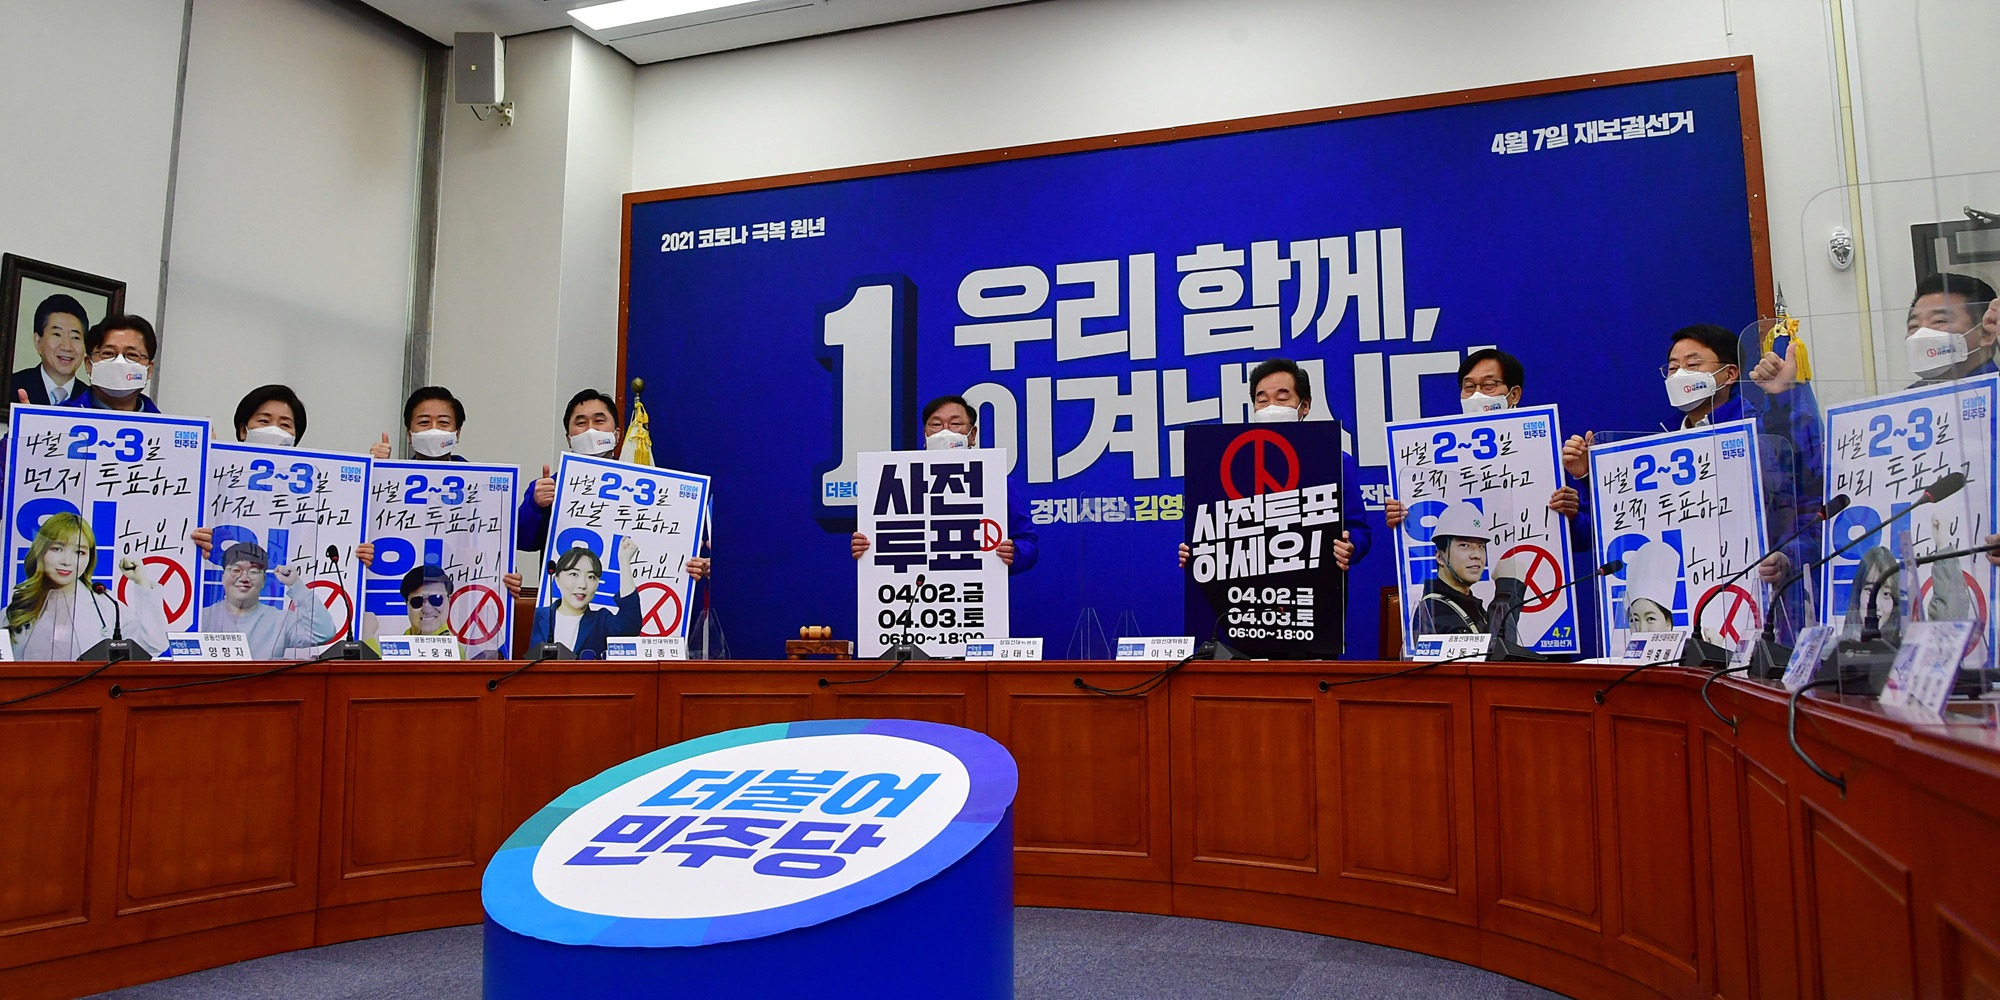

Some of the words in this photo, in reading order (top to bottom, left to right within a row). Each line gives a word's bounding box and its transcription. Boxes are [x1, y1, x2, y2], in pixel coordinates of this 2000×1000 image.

[1491, 130, 1529, 154] 4월
[1532, 124, 1569, 151] 7일
[1574, 110, 1695, 144] 재보궐선거
[661, 231, 694, 252] 2021
[698, 225, 748, 248] 코로나
[752, 221, 785, 242] 극복
[790, 217, 825, 239] 원년
[954, 252, 1156, 371] 우리
[1176, 227, 1441, 356] 함께,
[1963, 396, 1986, 409] 더불어
[1963, 408, 1986, 421] 민주당
[175, 431, 198, 440] 더불어
[1523, 421, 1545, 430] 더불어
[1524, 430, 1546, 439] 민주당
[27, 431, 64, 457] 4월
[174, 440, 198, 448] 민주당
[1401, 442, 1432, 466] 4월
[1721, 438, 1744, 449] 더불어
[1723, 449, 1745, 459] 민주당
[1838, 429, 1866, 460] 4월
[24, 468, 81, 494] 먼저
[96, 463, 191, 497] 투표하고
[213, 464, 245, 489] 4월
[341, 466, 361, 474] 더불어
[341, 474, 361, 482] 민주당
[490, 476, 509, 484] 더불어
[1412, 469, 1448, 498] 일찍
[1459, 464, 1534, 495] 투표하고
[1604, 467, 1632, 494] 4월
[1838, 469, 1872, 496] 미리
[372, 480, 402, 503] 4월
[489, 484, 509, 492] 민주당
[569, 474, 596, 496] 4월
[678, 491, 698, 500] 민주당
[679, 484, 698, 492] 더불어
[825, 482, 858, 498] 더불
[873, 461, 984, 516] 사전
[1360, 484, 1391, 511] 전
[211, 494, 261, 518] 사전
[269, 494, 352, 525] 투표하고
[376, 509, 421, 531] 사전
[425, 506, 501, 535] 투표하고
[567, 500, 610, 527] 전날
[614, 505, 681, 535] 투표하고
[1192, 483, 1339, 543] 사전투표
[1613, 498, 1646, 530] 일찍
[1658, 490, 1732, 525] 투표하고
[118, 518, 188, 554] 해요!
[1489, 505, 1549, 546] 해요!
[874, 519, 984, 573] 투표
[1193, 530, 1322, 583] 하세요!
[445, 551, 500, 583] 해요!
[630, 551, 685, 583] 해요!
[878, 582, 984, 604] 04.02.금
[1228, 587, 1314, 606] 04.02.금
[878, 607, 984, 628] 04.03.토
[1228, 607, 1314, 627] 04.03.토
[1228, 628, 1314, 641] 06:00~18:00
[1552, 627, 1571, 638] 4.7
[637, 769, 941, 818] 더불어
[563, 815, 887, 879] 민주당
